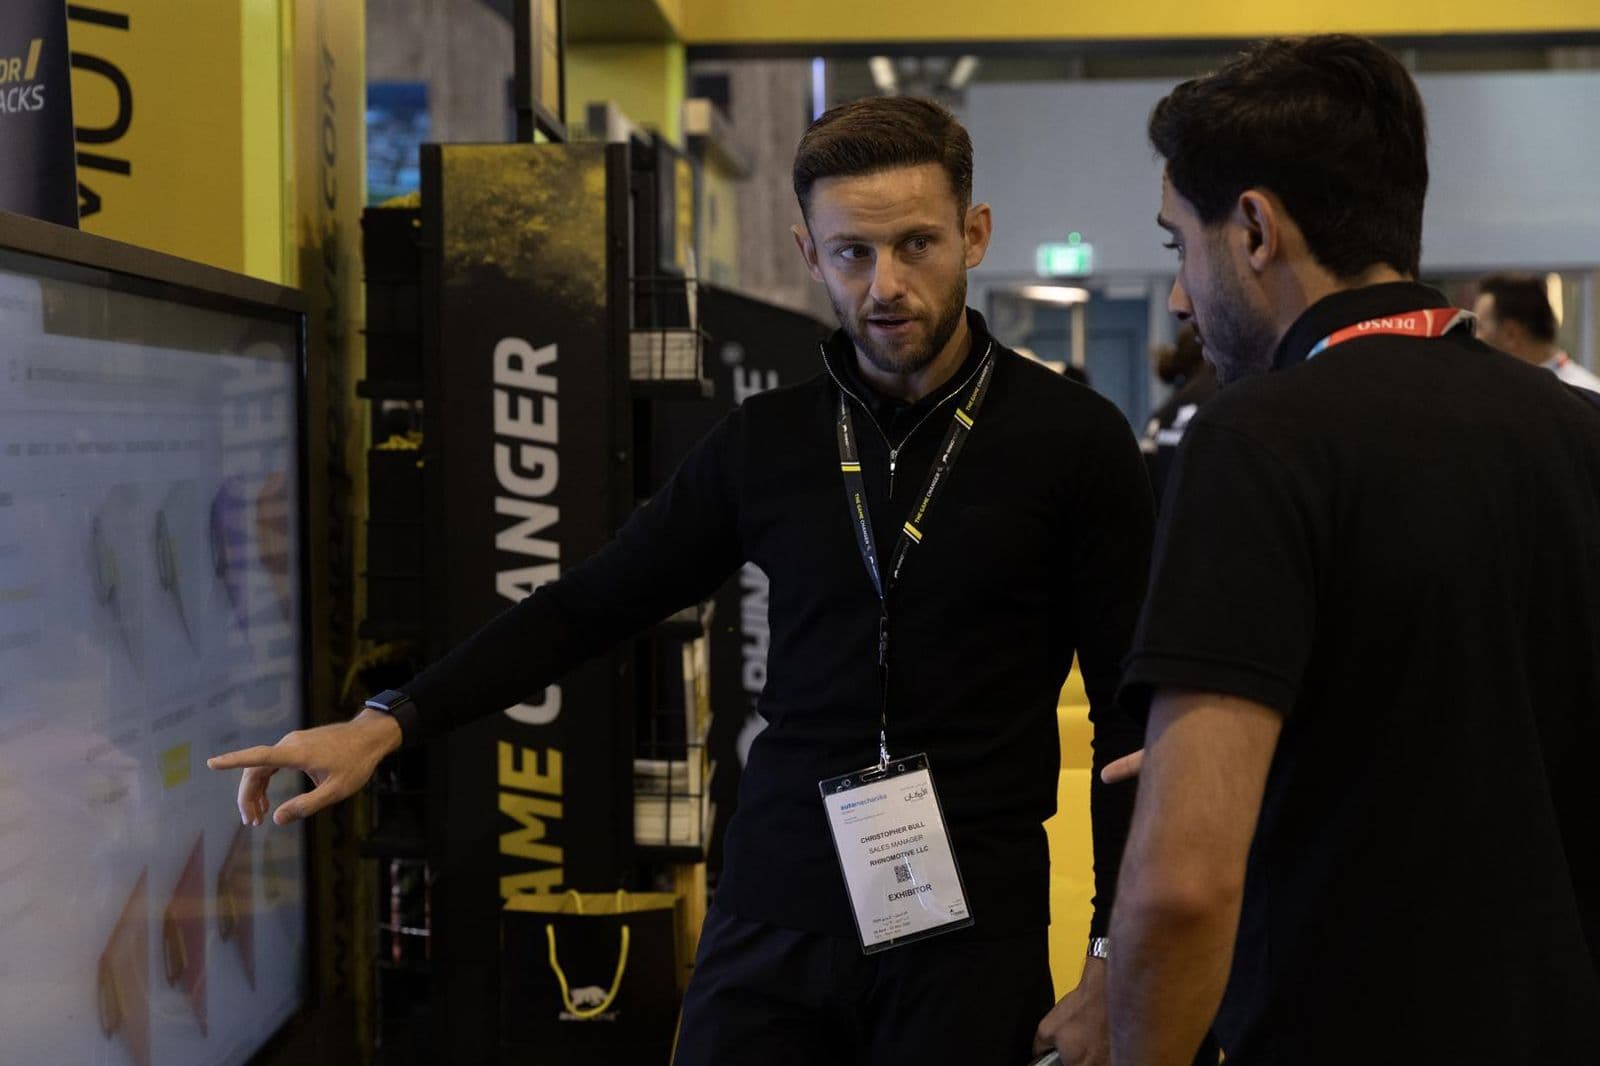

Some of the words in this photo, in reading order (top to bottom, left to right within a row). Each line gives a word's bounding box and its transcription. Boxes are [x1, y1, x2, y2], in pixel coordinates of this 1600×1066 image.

[1357, 318, 1415, 331] DENSO
[914, 512, 922, 524] THE
[918, 496, 930, 513] GAME
[926, 472, 940, 498] CHANGER
[856, 504, 864, 519] GAME
[860, 519, 870, 544] CHANGER
[860, 825, 908, 844] CHRISTOPHER
[908, 821, 925, 832] BULL
[868, 842, 890, 854] SALES
[890, 834, 923, 847] MANAGER
[869, 850, 915, 867] RHINOMOTIVE
[916, 845, 929, 856] LLC
[888, 884, 933, 902] EXHIBITOR
